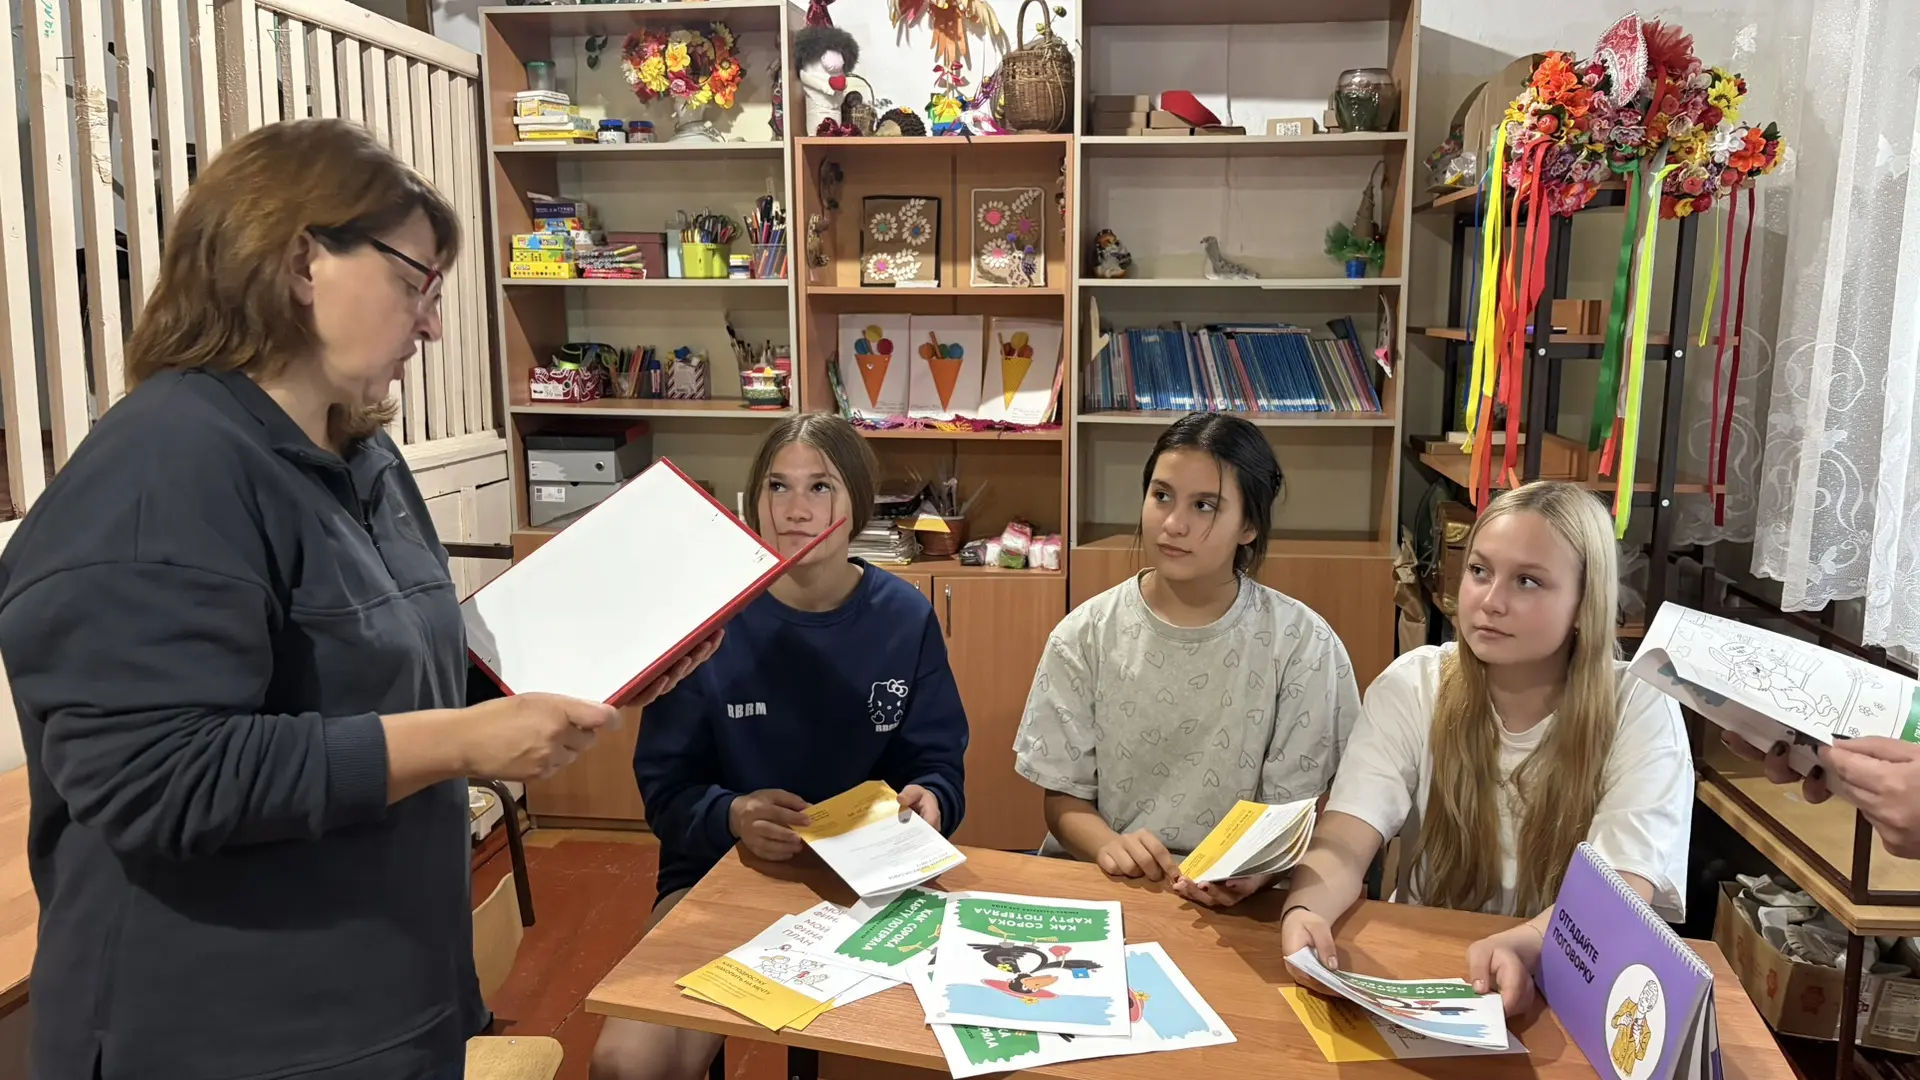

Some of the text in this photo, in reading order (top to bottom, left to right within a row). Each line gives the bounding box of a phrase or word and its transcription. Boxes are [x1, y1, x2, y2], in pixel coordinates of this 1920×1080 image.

[727, 702, 767, 719] RBRM
[900, 898, 927, 919] КАРТУ
[913, 909, 933, 923] КАК
[973, 907, 1043, 921] ПОТЕРЯЛА
[988, 917, 1077, 931] КАК СОРОКА
[1049, 915, 1092, 925] КАРТУ
[782, 929, 814, 946] ПЛАН
[861, 917, 904, 951] ПОТЕРЯЛА
[884, 922, 918, 948] СОРОКА
[1559, 909, 1599, 964] ОТГАДАЙТЕ
[1552, 926, 1595, 984] ПОГОВОРКУ
